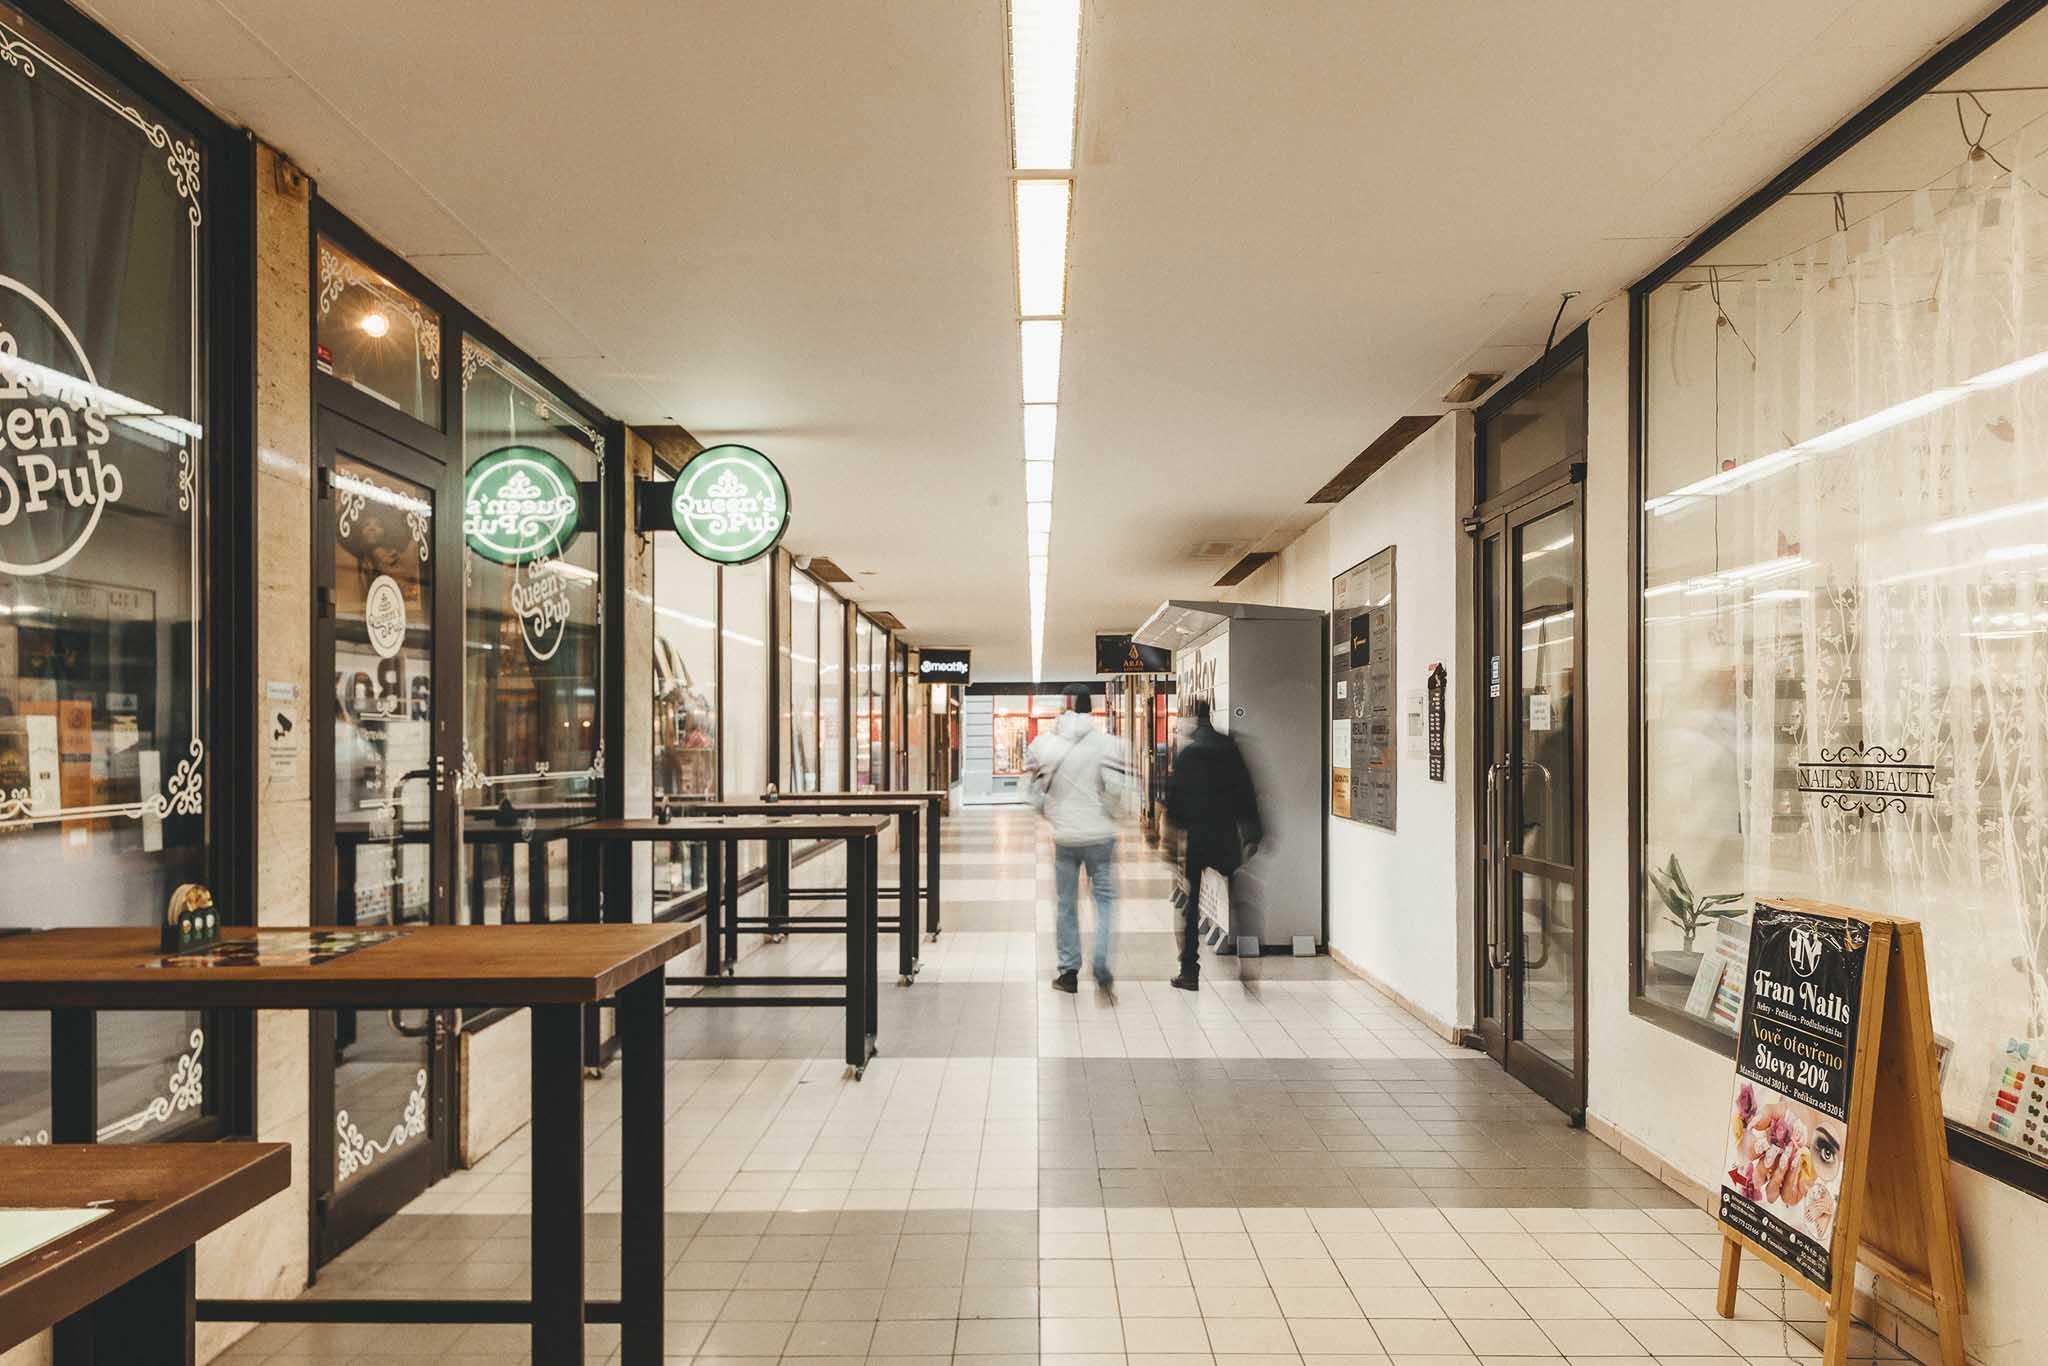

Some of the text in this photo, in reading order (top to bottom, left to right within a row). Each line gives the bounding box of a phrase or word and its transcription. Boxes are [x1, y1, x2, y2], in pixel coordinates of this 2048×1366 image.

[18, 450, 123, 513] Pub
[676, 490, 777, 514] Queen's
[728, 512, 780, 534] Pub
[544, 596, 571, 629] Pub
[1798, 768, 1936, 794] NAILS & BEAUTY
[1754, 969, 1850, 1024] Tran Nails
[1755, 1043, 1829, 1095] Sleva 20%
[1783, 1035, 1843, 1071] otevřeno
